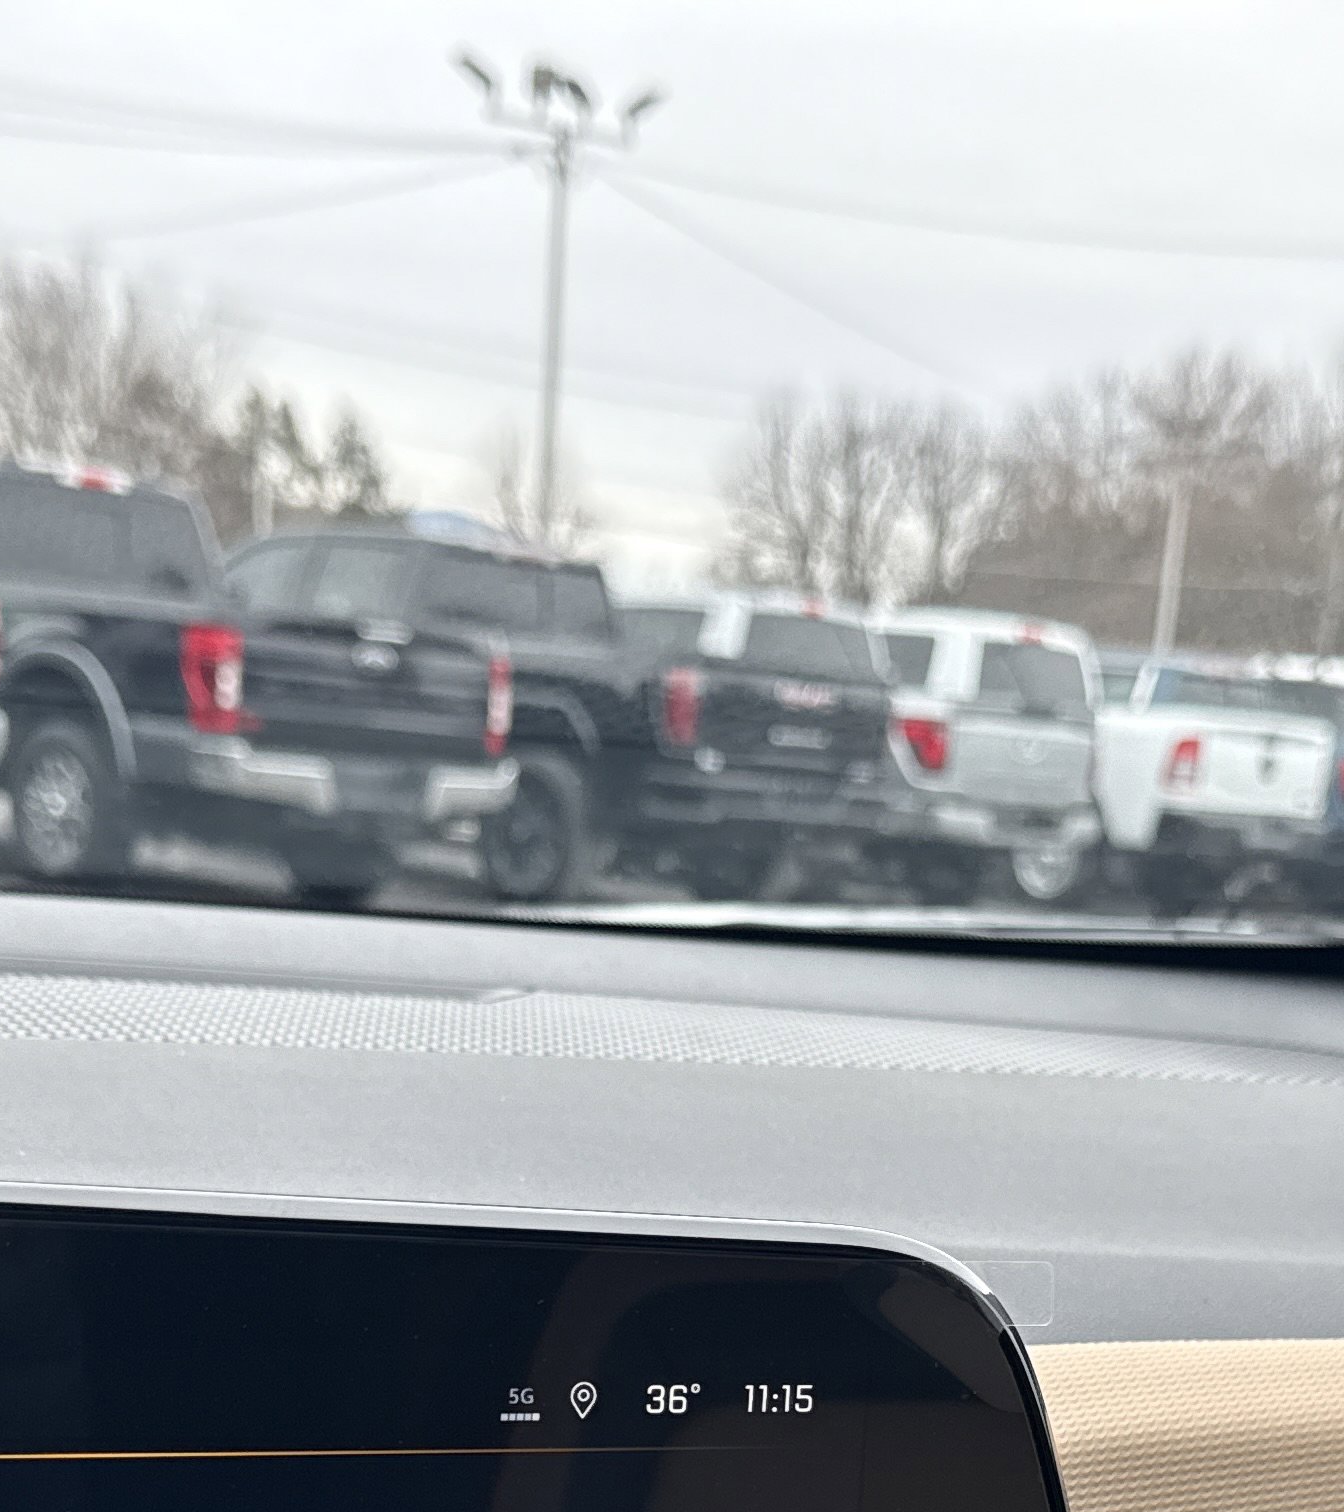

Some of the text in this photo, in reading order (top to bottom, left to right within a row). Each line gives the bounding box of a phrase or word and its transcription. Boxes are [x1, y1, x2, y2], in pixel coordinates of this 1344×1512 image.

[509, 1387, 535, 1405] 5G
[645, 1383, 701, 1414] 36°
[744, 1384, 814, 1413] 11:15
